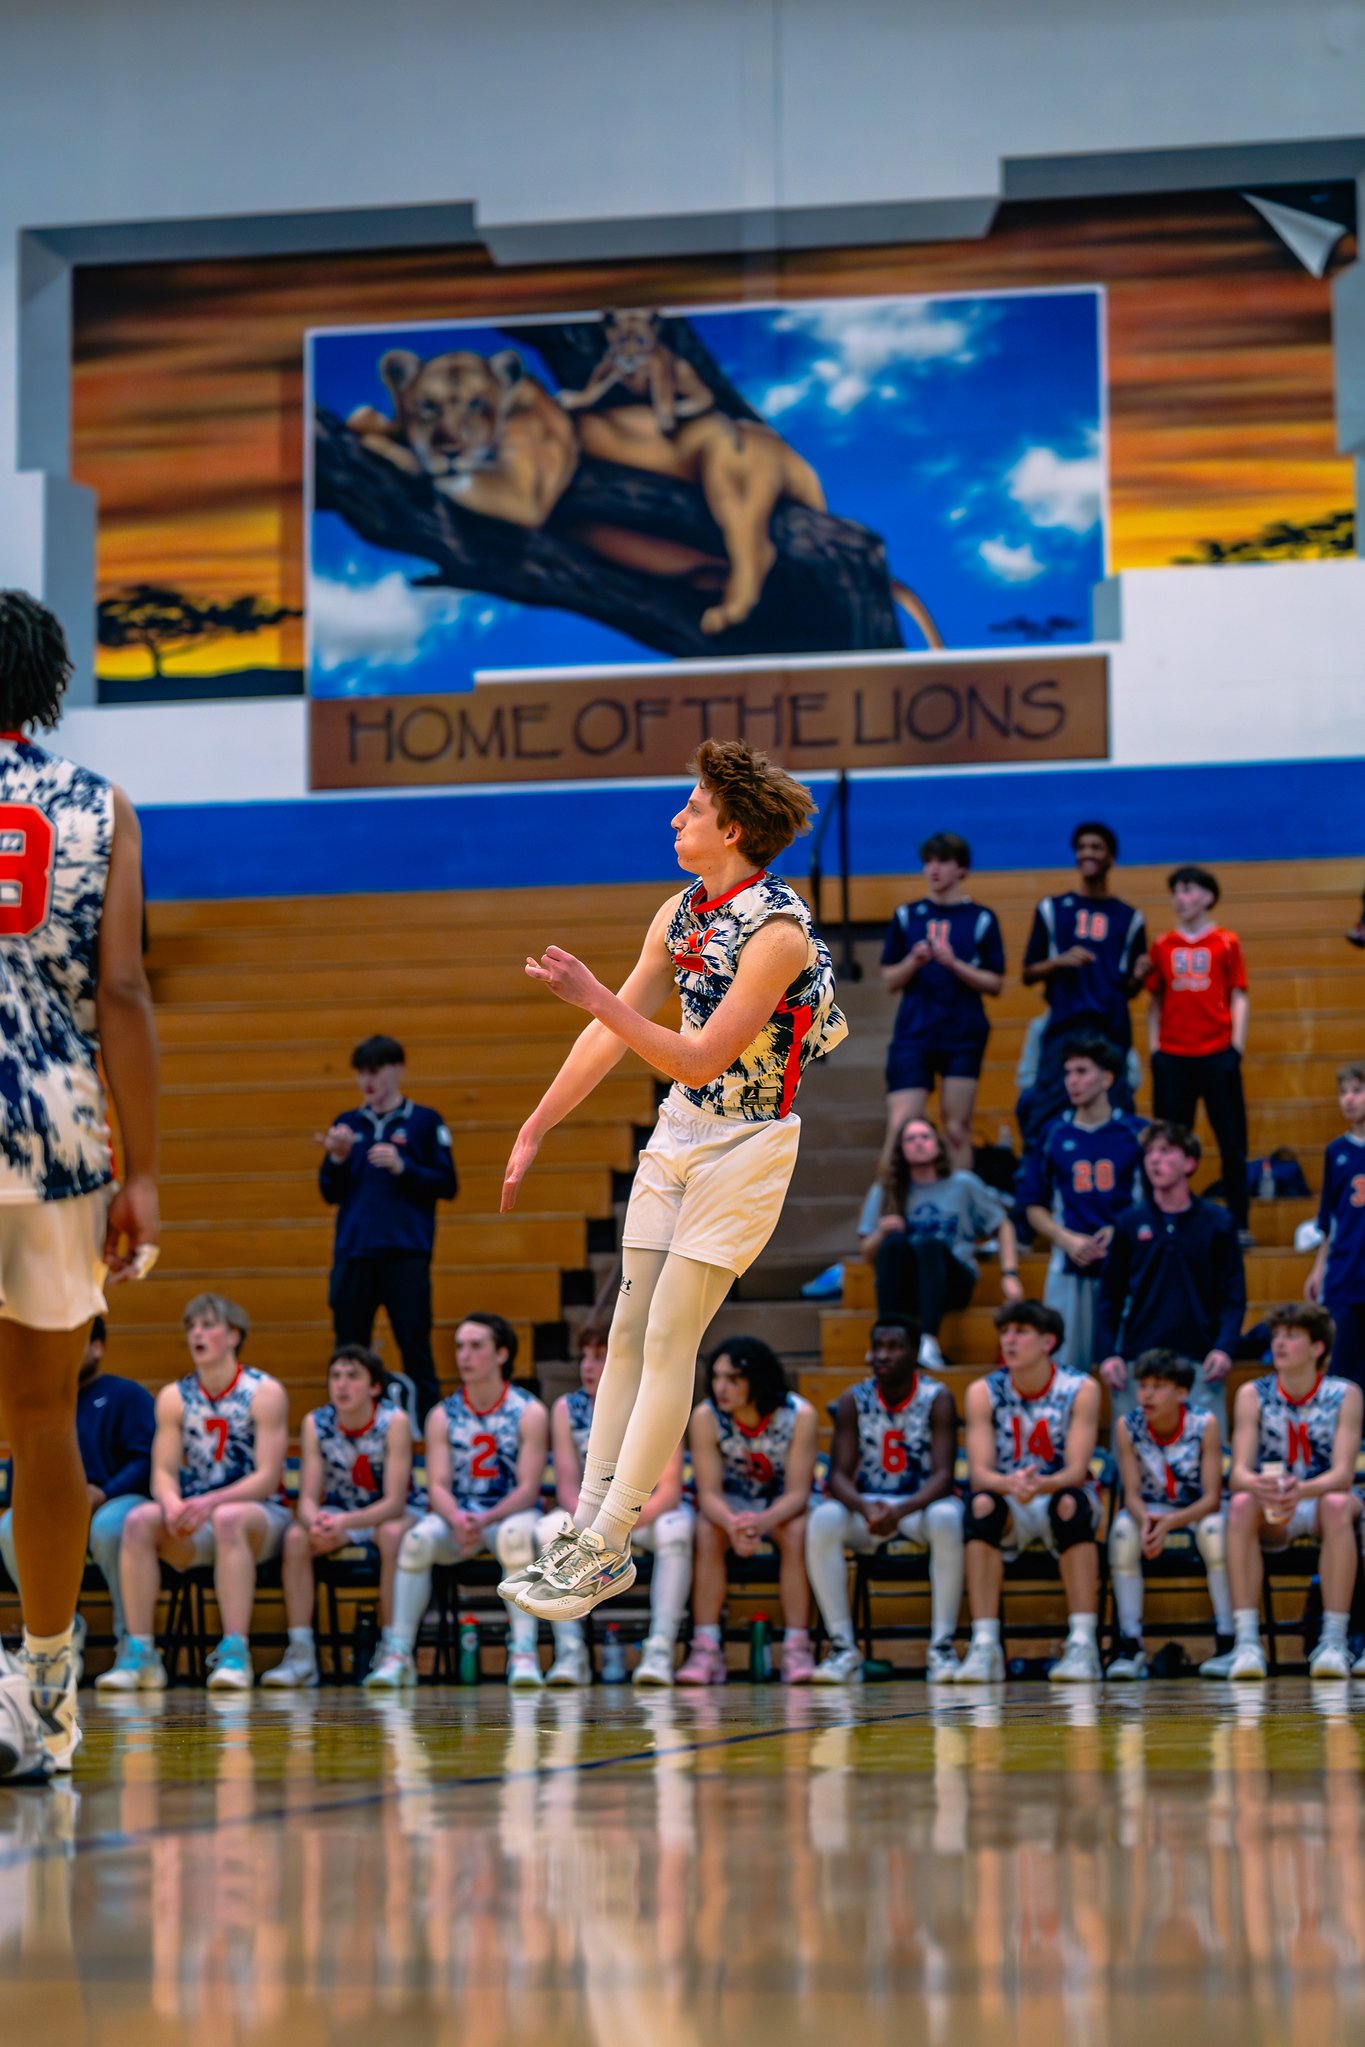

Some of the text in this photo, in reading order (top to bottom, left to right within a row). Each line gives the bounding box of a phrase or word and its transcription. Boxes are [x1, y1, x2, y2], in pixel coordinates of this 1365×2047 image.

[347, 679, 1066, 764] HOME OF THE LIONS
[1072, 1159, 1115, 1193] 20
[204, 1417, 229, 1463] 7
[471, 1433, 500, 1479] 2
[882, 1430, 907, 1473] 6
[1012, 1416, 1056, 1463] 14
